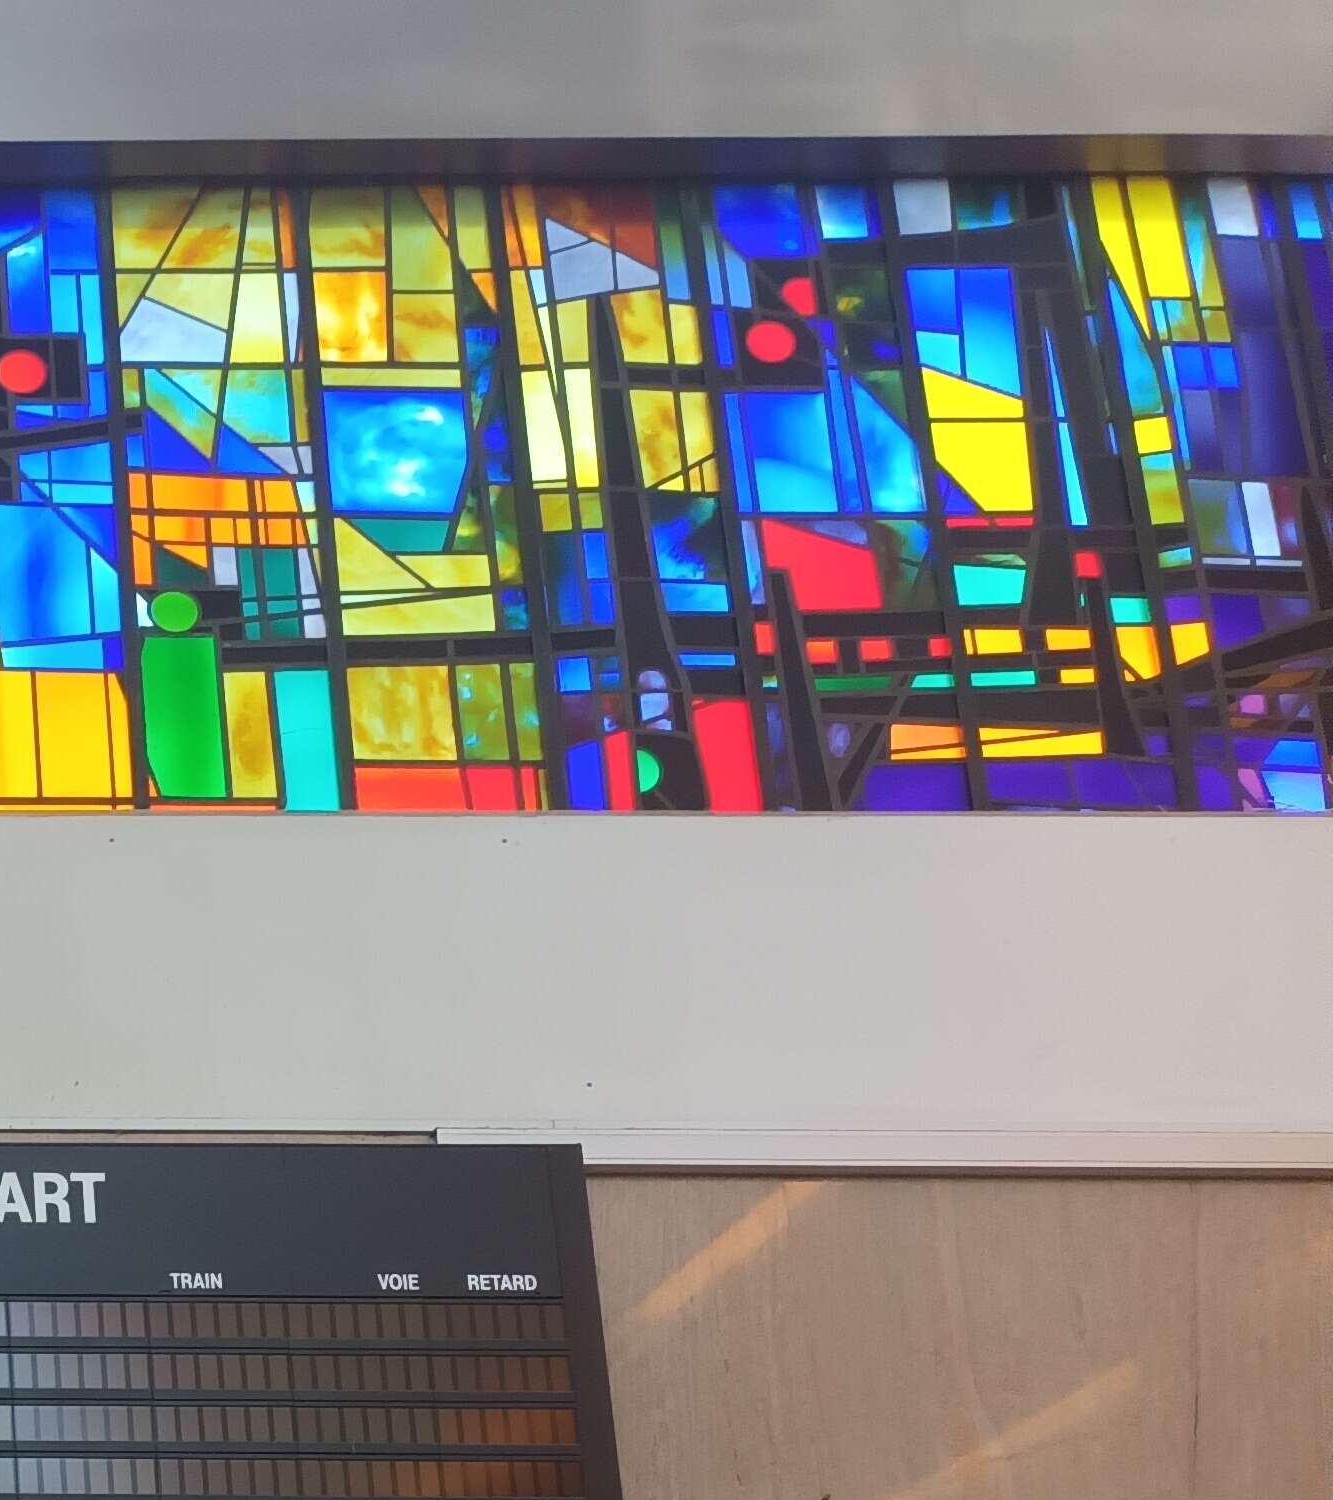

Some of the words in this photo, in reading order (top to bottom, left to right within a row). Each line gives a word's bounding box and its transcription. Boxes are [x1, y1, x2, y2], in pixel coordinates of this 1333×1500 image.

[169, 1272, 223, 1290] TRAIN
[376, 1273, 420, 1291] VOIE
[466, 1274, 538, 1292] RETARD
